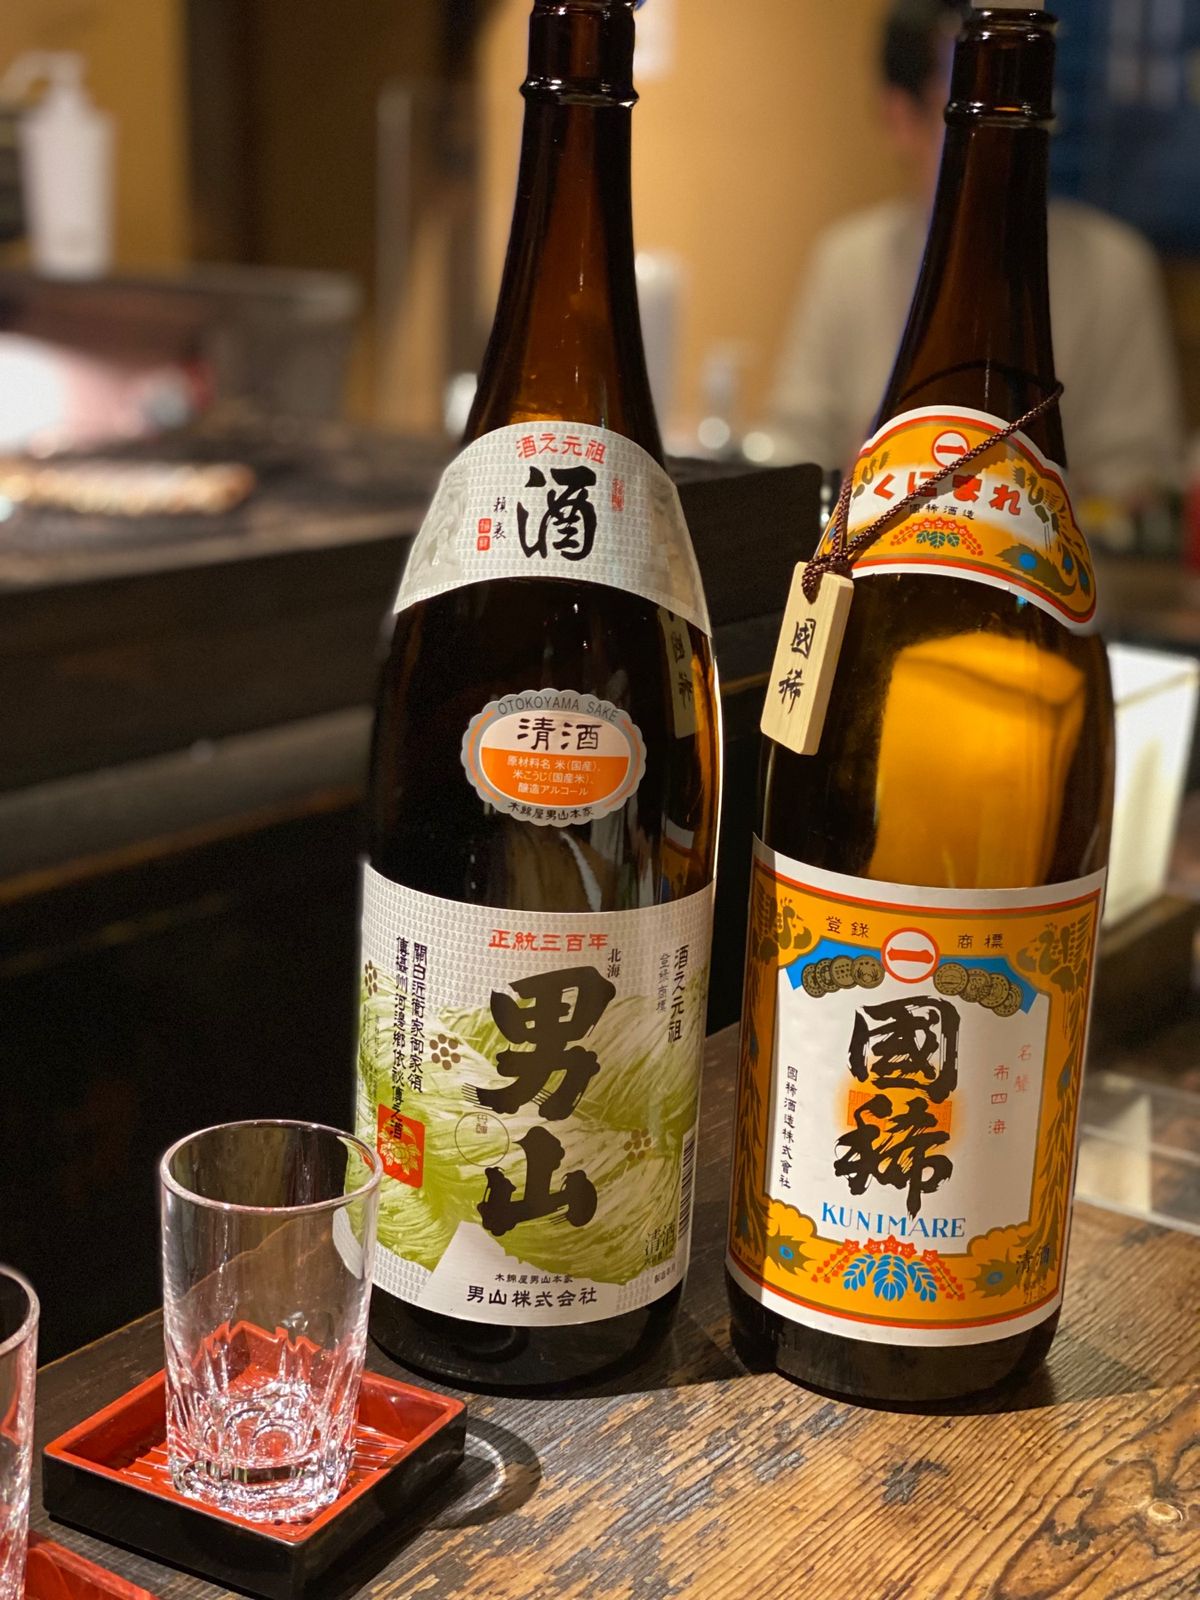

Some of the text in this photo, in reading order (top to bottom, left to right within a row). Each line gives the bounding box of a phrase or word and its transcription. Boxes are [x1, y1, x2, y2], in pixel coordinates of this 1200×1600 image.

[873, 470, 1021, 516] くにまれ
[516, 465, 597, 561] 酒
[498, 695, 619, 722] OTOKOYAMA SAKE
[516, 716, 602, 751] 清酒
[507, 754, 551, 769] 原材料名
[488, 929, 609, 952] 正統三百年
[957, 933, 1004, 950] 商標
[461, 965, 616, 1237] 男山
[822, 1202, 966, 1238] KUNIMARE
[466, 1285, 598, 1308] 男山株式会社
